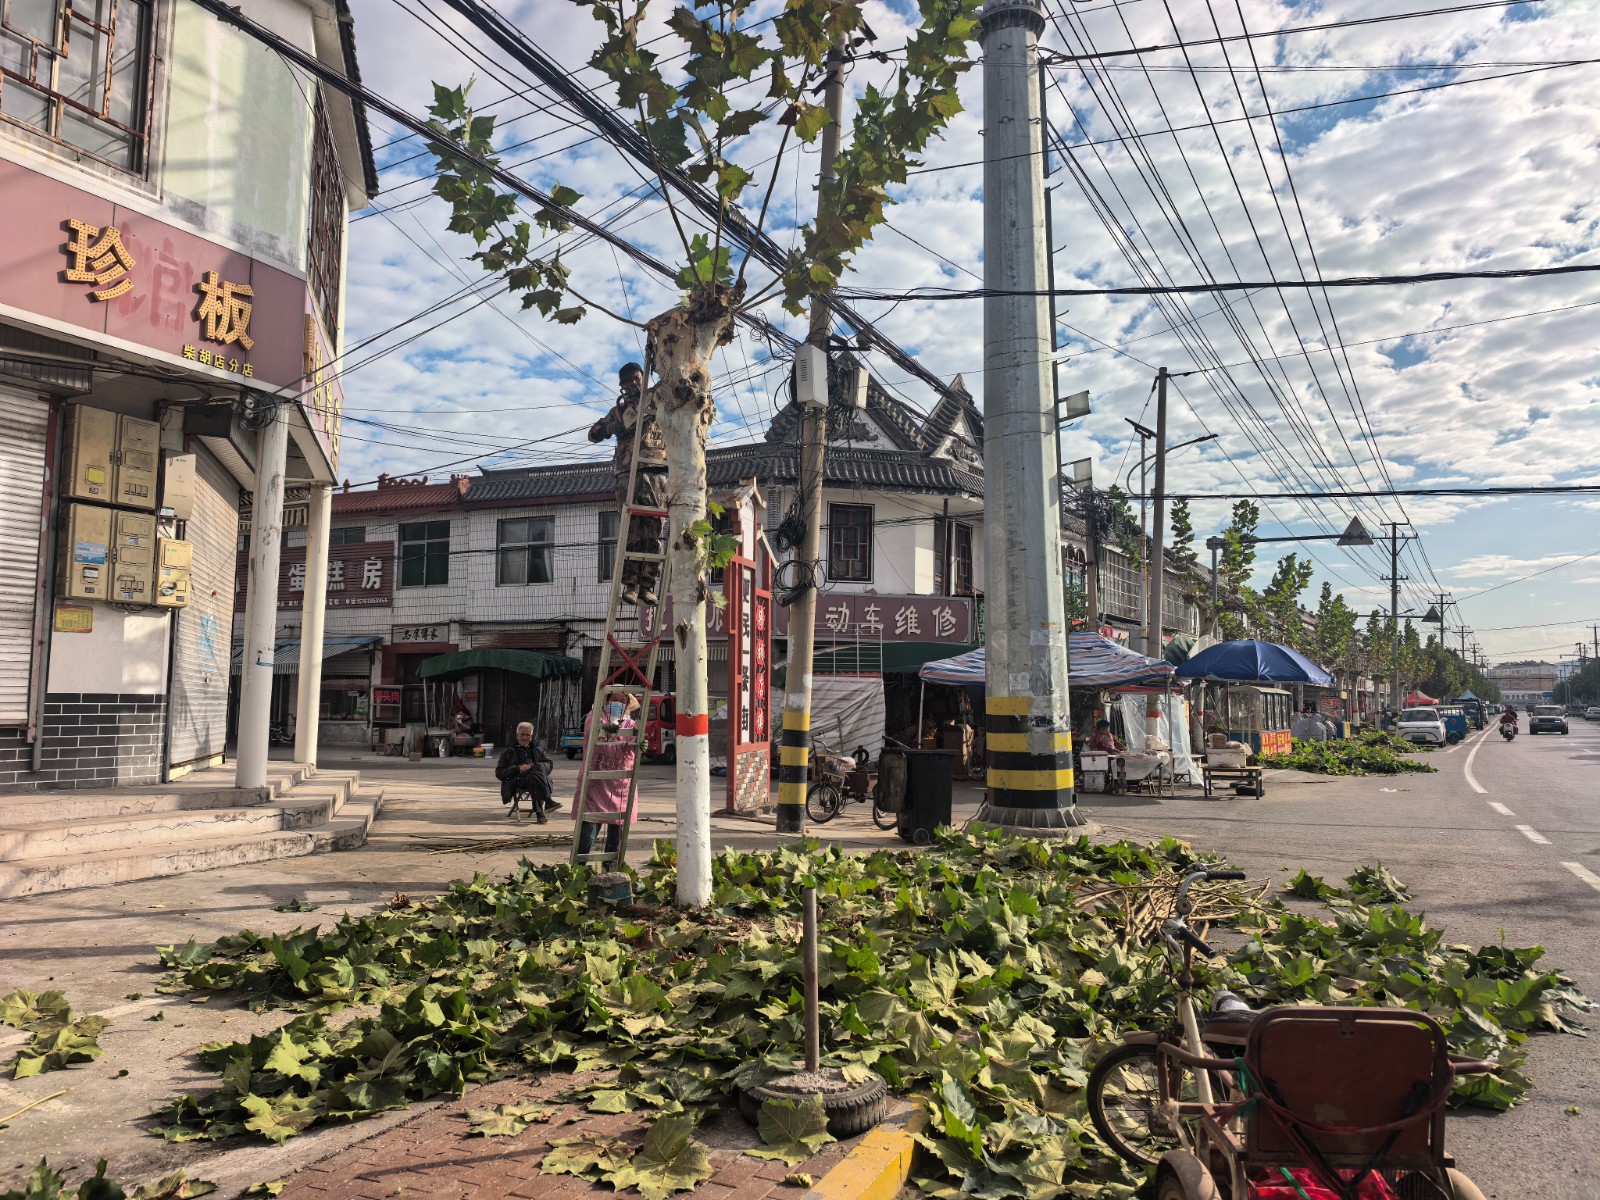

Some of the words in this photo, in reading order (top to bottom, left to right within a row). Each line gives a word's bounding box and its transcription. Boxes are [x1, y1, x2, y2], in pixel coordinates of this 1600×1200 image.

[183, 343, 254, 378] 柴胡店分店
[825, 601, 957, 638] 动车维修
